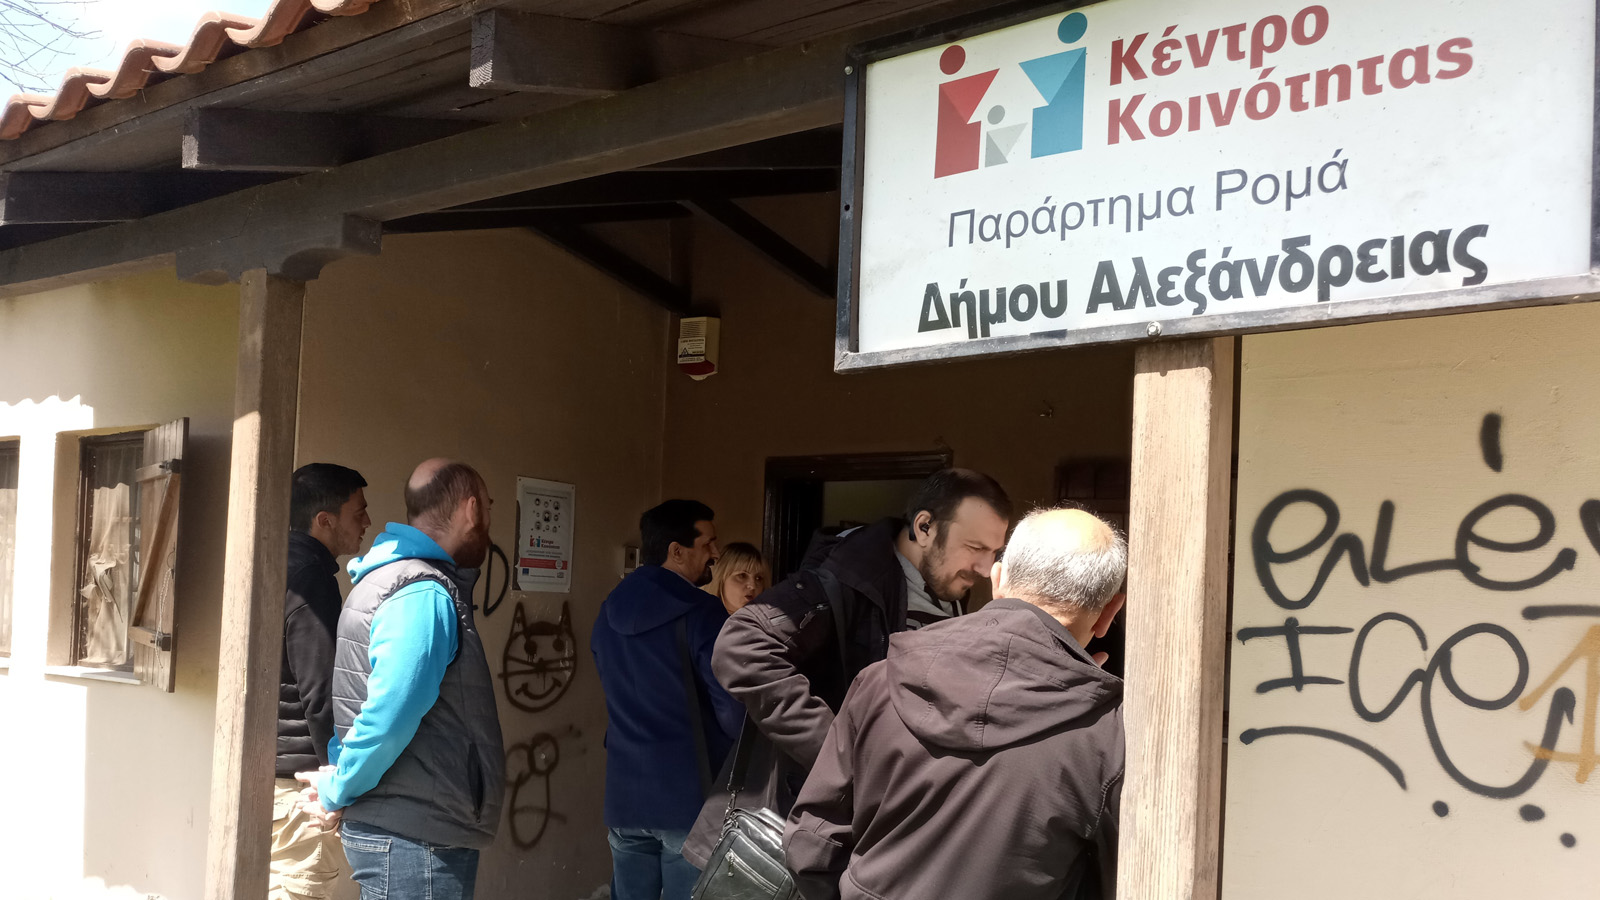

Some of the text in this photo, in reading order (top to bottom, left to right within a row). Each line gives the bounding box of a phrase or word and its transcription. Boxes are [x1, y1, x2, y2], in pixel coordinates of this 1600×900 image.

[1107, 36, 1474, 146] Κοινότητας
[1109, 4, 1329, 86] Κέντρο
[948, 148, 1349, 249] Παράρτημα Ρομά
[917, 224, 1489, 339] Δήμου Αλεξάνδρειας
